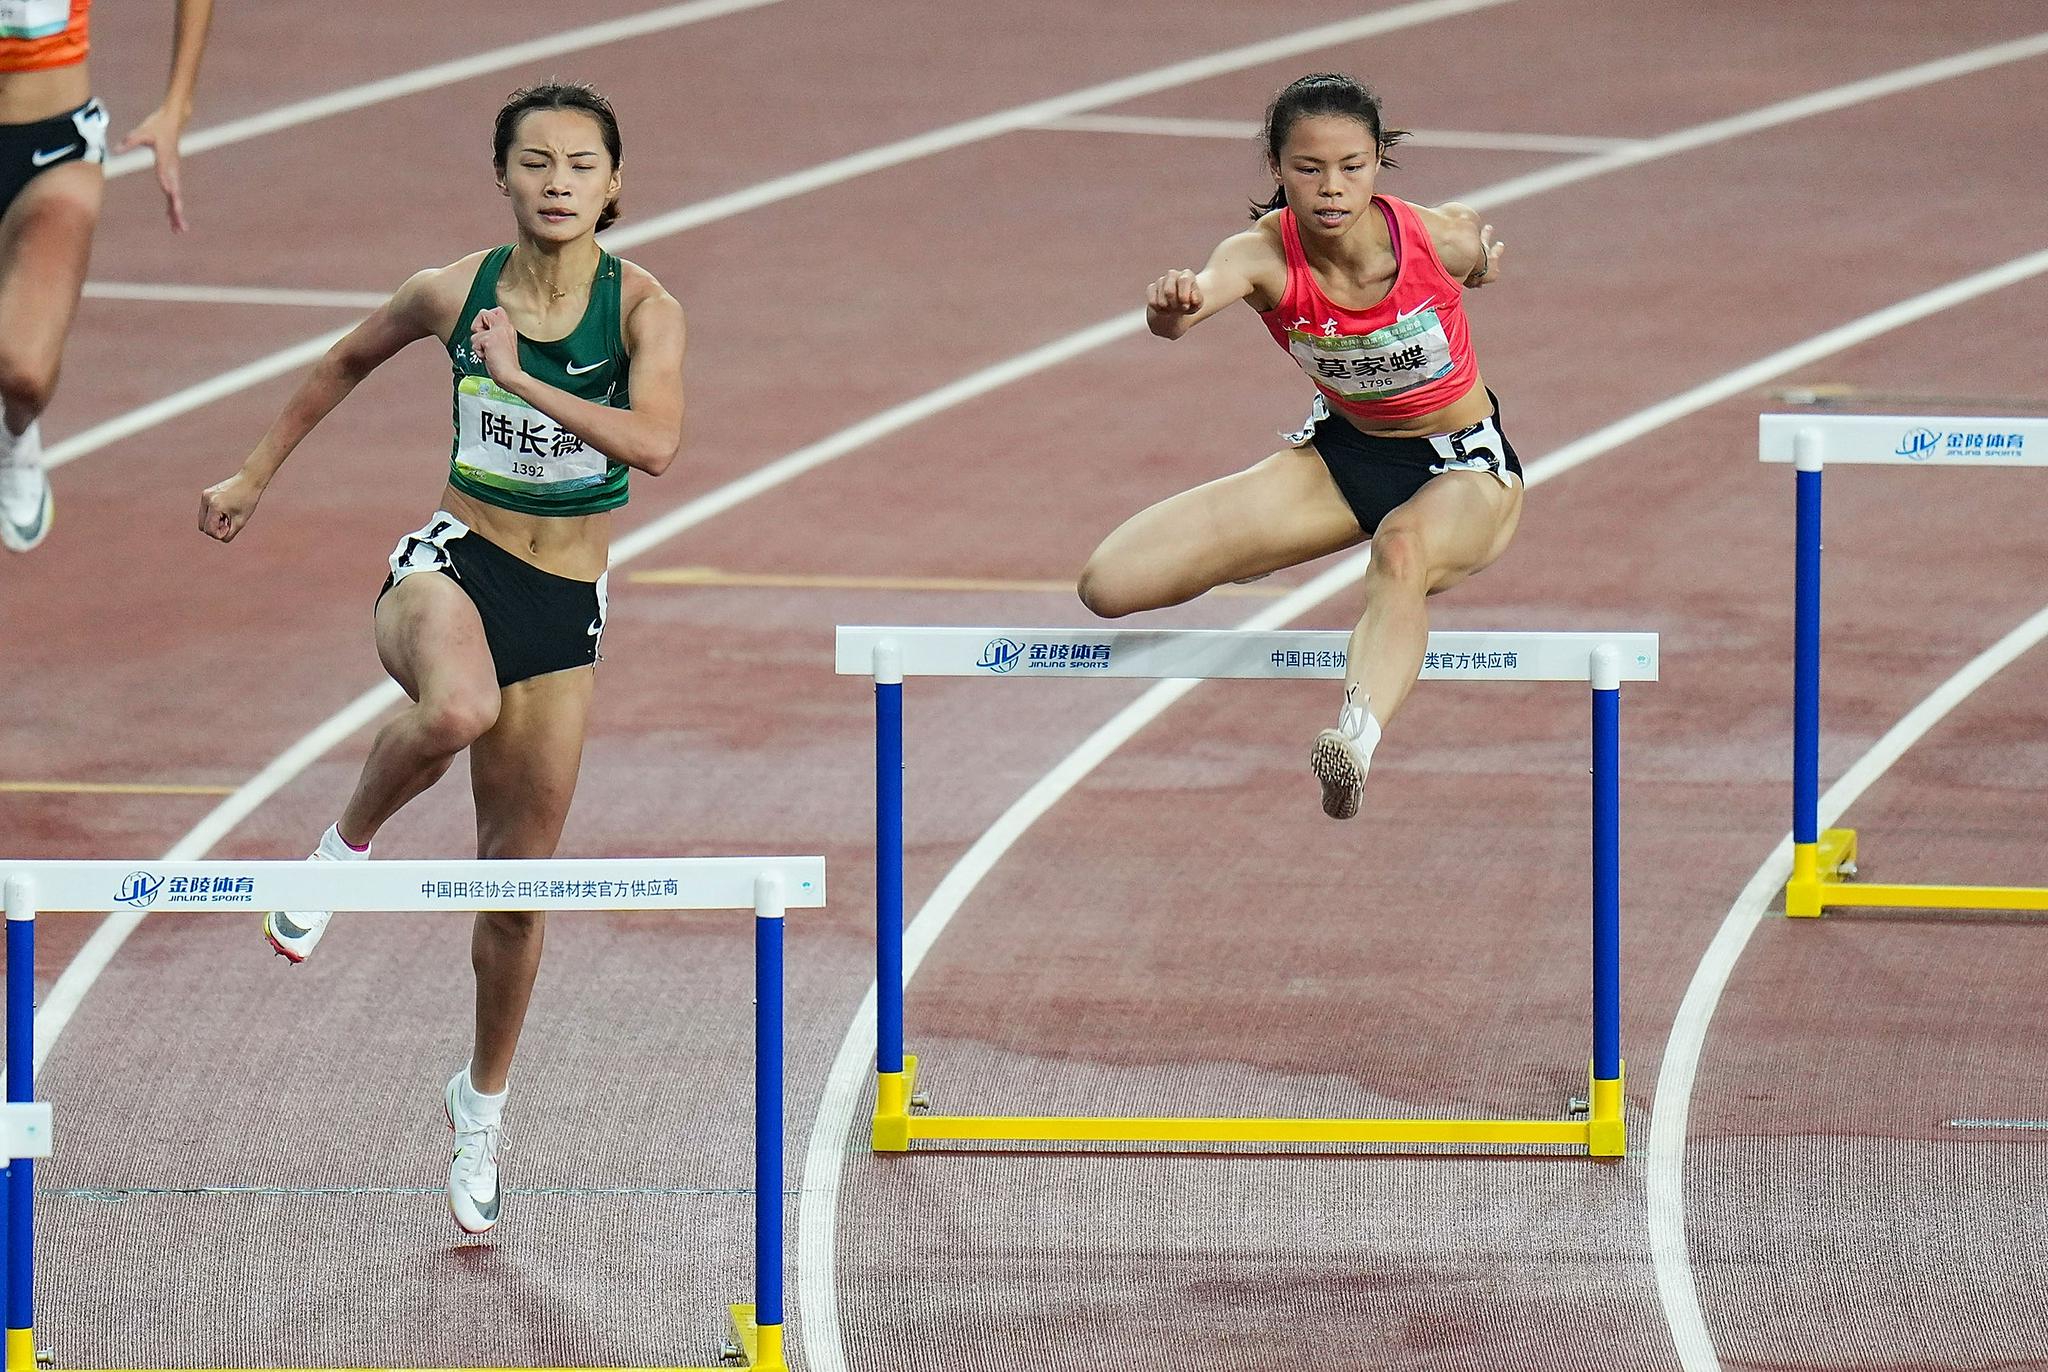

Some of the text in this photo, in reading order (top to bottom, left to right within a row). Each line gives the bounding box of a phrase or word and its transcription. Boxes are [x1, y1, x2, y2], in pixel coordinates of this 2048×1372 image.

[1313, 344, 1429, 379] 莫家蝶
[1359, 377, 1393, 389] 1796
[481, 410, 584, 458] 陆长薇
[1946, 432, 2025, 448] 金陵体育
[512, 461, 545, 478] 1392
[1028, 643, 1112, 660] 金陵体育
[168, 876, 255, 893] 金陵体育
[421, 878, 679, 898] 中国田径协会田径器材类官方供应商
